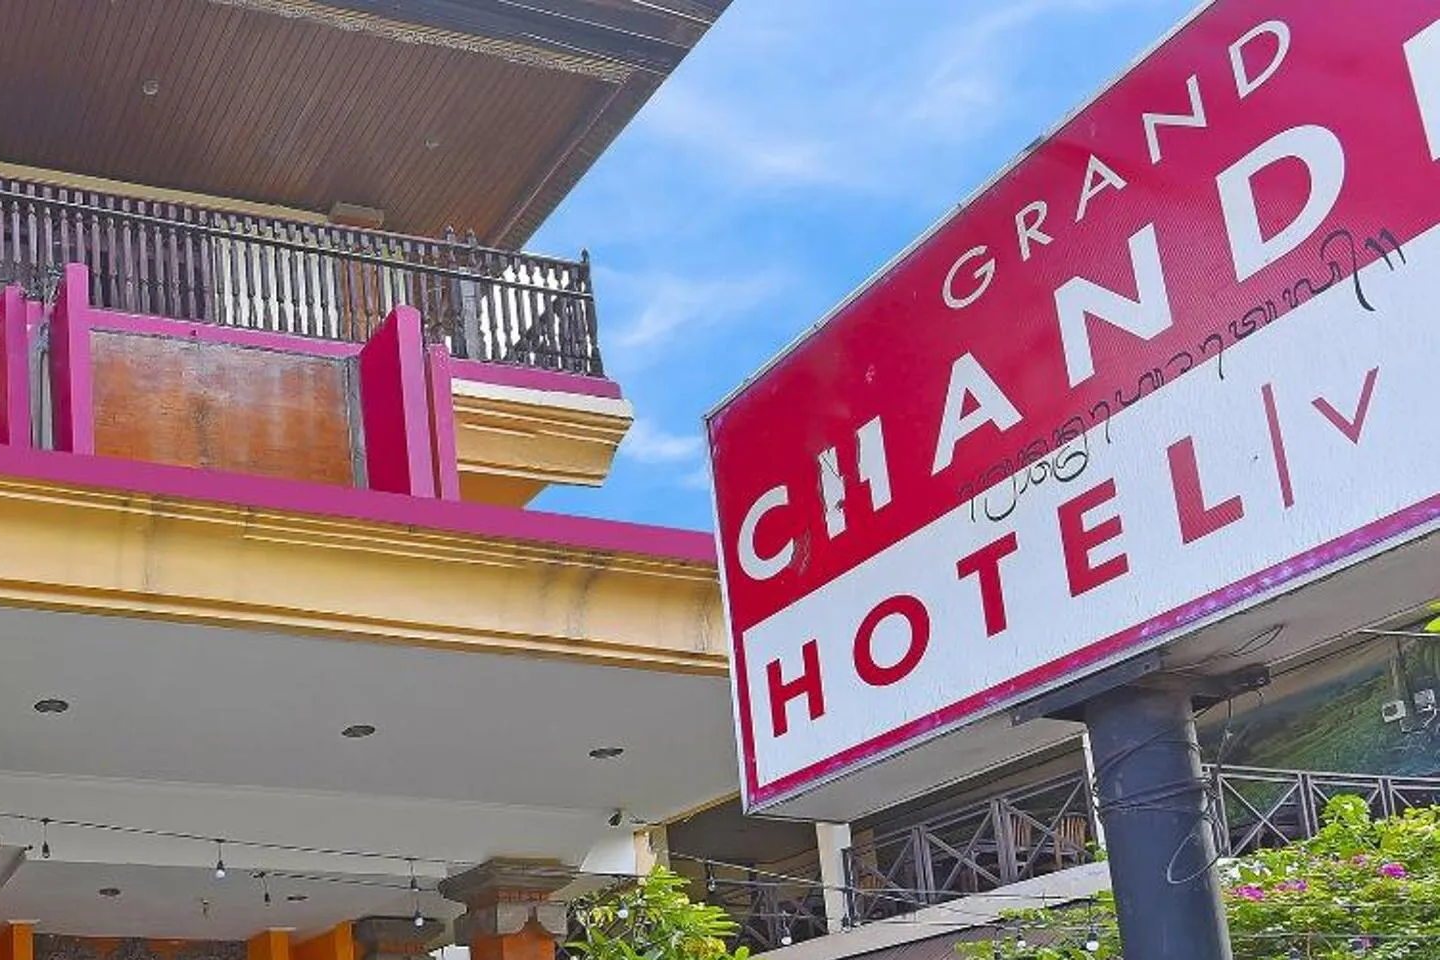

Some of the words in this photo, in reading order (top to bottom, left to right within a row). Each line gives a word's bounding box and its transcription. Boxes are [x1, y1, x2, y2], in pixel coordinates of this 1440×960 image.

[736, 19, 1440, 582] CHAND
[941, 20, 1291, 308] GRAND
[764, 434, 1245, 738] HOTEL
